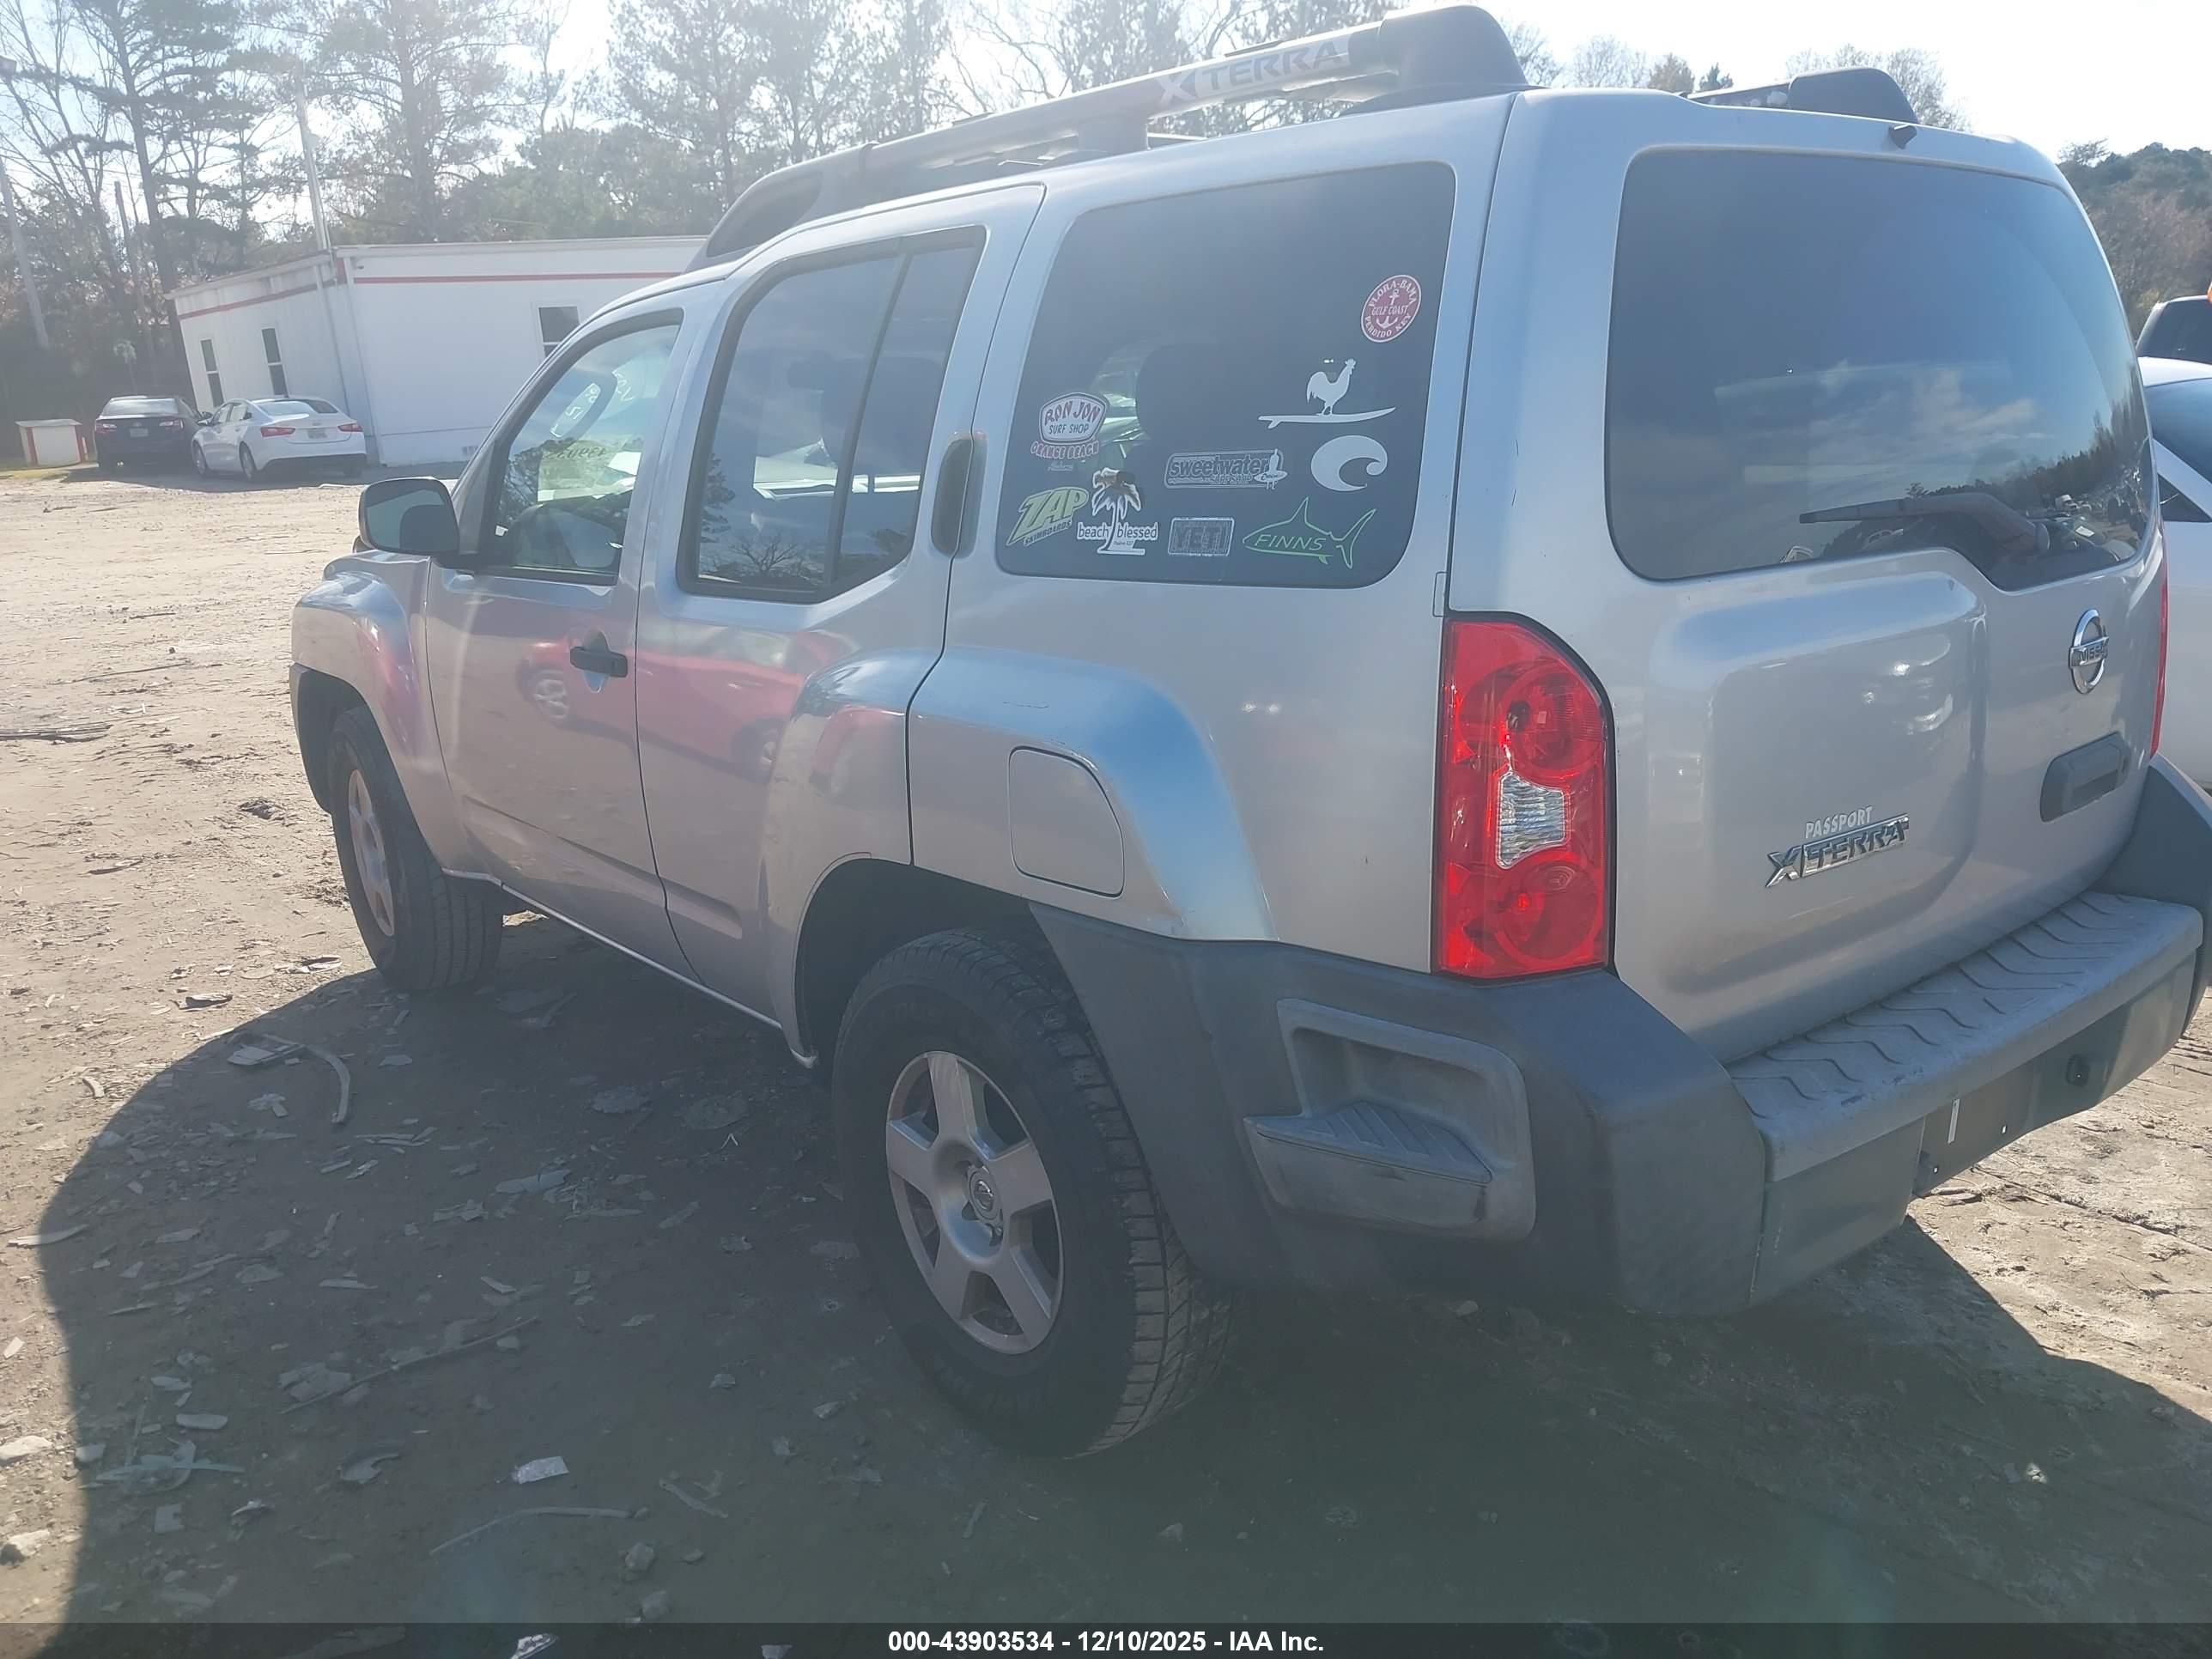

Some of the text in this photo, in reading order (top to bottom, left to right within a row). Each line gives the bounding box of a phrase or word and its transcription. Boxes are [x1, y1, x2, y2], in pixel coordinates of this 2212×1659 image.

[1160, 41, 1343, 104] XTERRA
[1389, 304, 1409, 315] COAST
[1364, 313, 1412, 338] PERDIDO KEY
[1044, 400, 1101, 426] RON JON
[1048, 423, 1090, 434] SURF SHOP
[1030, 440, 1099, 459] ORANGE BEACH
[1169, 454, 1271, 477] sweetwater
[1008, 488, 1089, 544] ZAP
[1078, 523, 1158, 539] beach blessed
[1254, 534, 1327, 551] FINNS
[1805, 805, 1873, 839] PASSPORT
[1765, 817, 1907, 888] XTERRA
